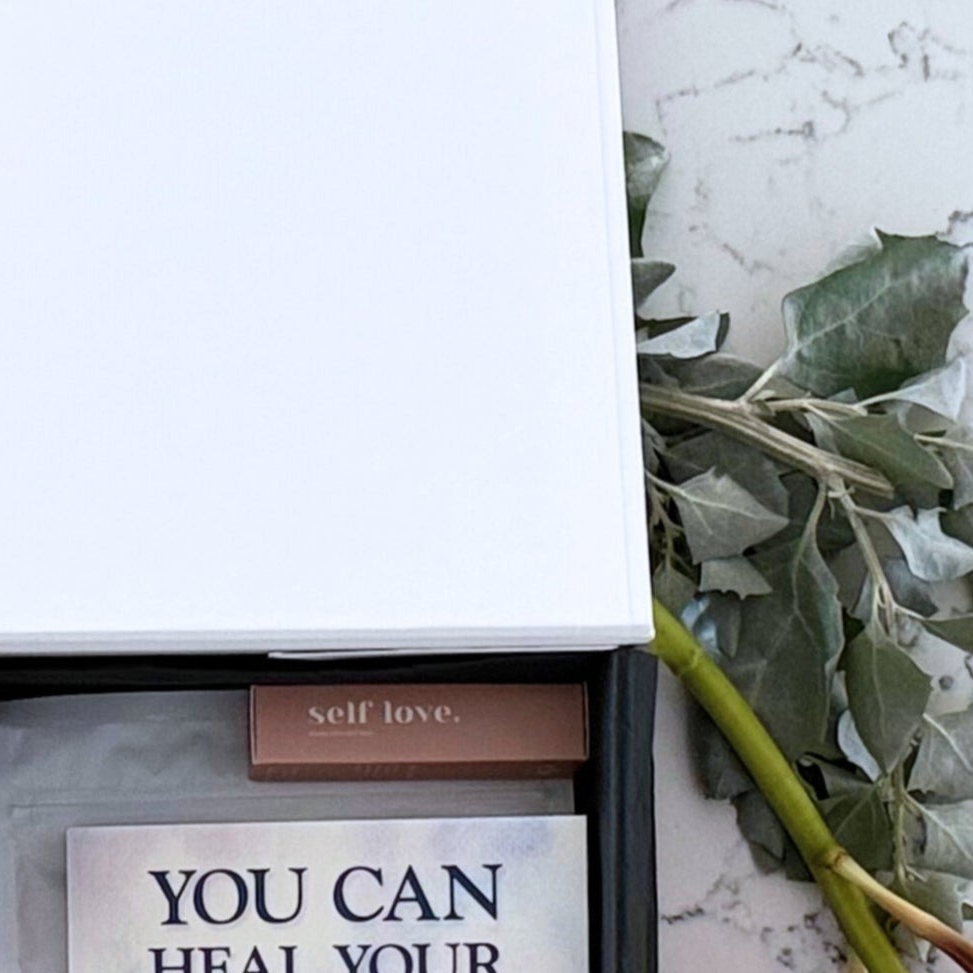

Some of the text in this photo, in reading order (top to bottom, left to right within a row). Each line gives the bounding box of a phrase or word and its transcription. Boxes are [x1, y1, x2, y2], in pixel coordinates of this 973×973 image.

[308, 700, 460, 724] self love.
[148, 864, 503, 925] YOU CAN
